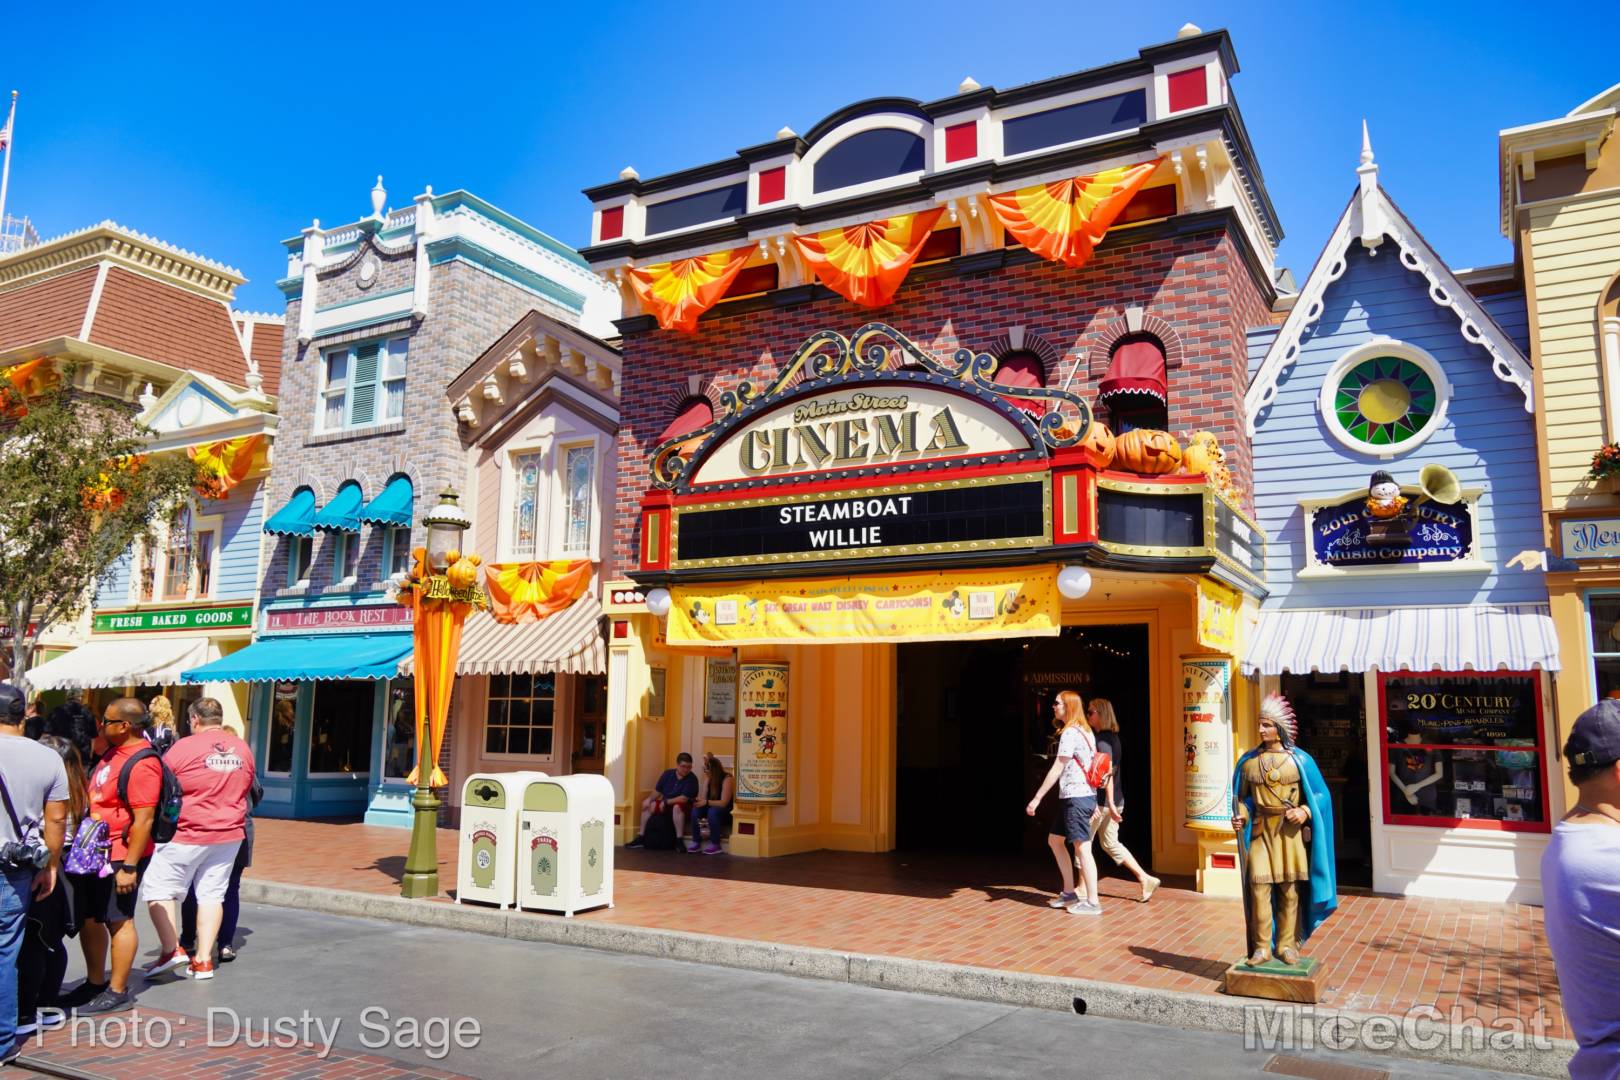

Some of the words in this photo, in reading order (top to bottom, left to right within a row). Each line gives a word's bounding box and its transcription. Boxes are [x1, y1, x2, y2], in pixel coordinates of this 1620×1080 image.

[794, 400, 847, 425] Main
[847, 392, 909, 412] Street
[739, 407, 969, 471] CINEMA
[779, 496, 912, 525] STEAMBOAT
[1319, 511, 1359, 537] 20th
[1361, 502, 1465, 530] CURY
[808, 526, 882, 548] WILLIE
[1324, 549, 1377, 562] Music
[1379, 545, 1463, 559] Company
[782, 602, 808, 613] GREAT
[811, 602, 832, 612] WALT
[836, 600, 869, 611] DISNEY
[875, 597, 932, 609] CARTOONS!
[110, 616, 144, 628] FRESH
[151, 614, 187, 626] BAKED
[195, 611, 233, 623] GOODS
[296, 612, 320, 626] THE
[324, 610, 355, 623] BOOK
[360, 608, 387, 622] REST
[1031, 672, 1083, 685] ADMISSION
[742, 691, 786, 702] CINEM
[1441, 694, 1513, 710] CENTURY
